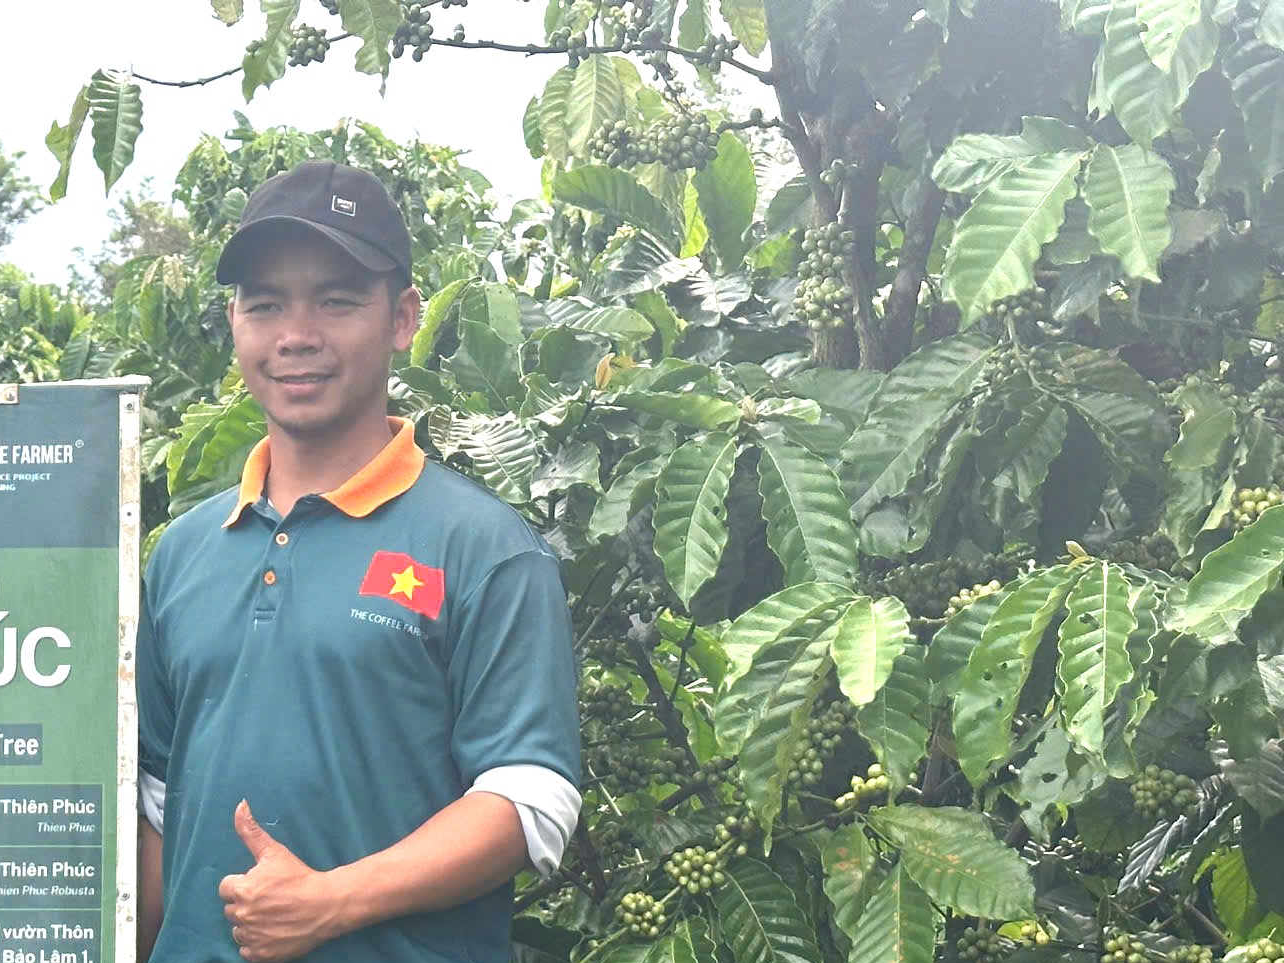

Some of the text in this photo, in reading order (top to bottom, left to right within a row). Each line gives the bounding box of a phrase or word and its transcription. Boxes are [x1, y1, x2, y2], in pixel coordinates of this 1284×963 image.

[13, 445, 73, 464] FARMER
[13, 472, 50, 483] PROJECT
[350, 608, 367, 620] THE
[368, 612, 402, 631] COFFEE
[0, 799, 95, 814] Thiên Phúc
[38, 821, 95, 833] Thien Phuc
[0, 862, 47, 877] Thiên
[53, 862, 94, 877] Phúc
[22, 884, 49, 896] Phuc
[51, 885, 94, 896] Robusta
[3, 924, 46, 939] vườn
[51, 924, 93, 939] Thôn
[3, 949, 35, 963] Bảo
[40, 950, 76, 963] Lâm
